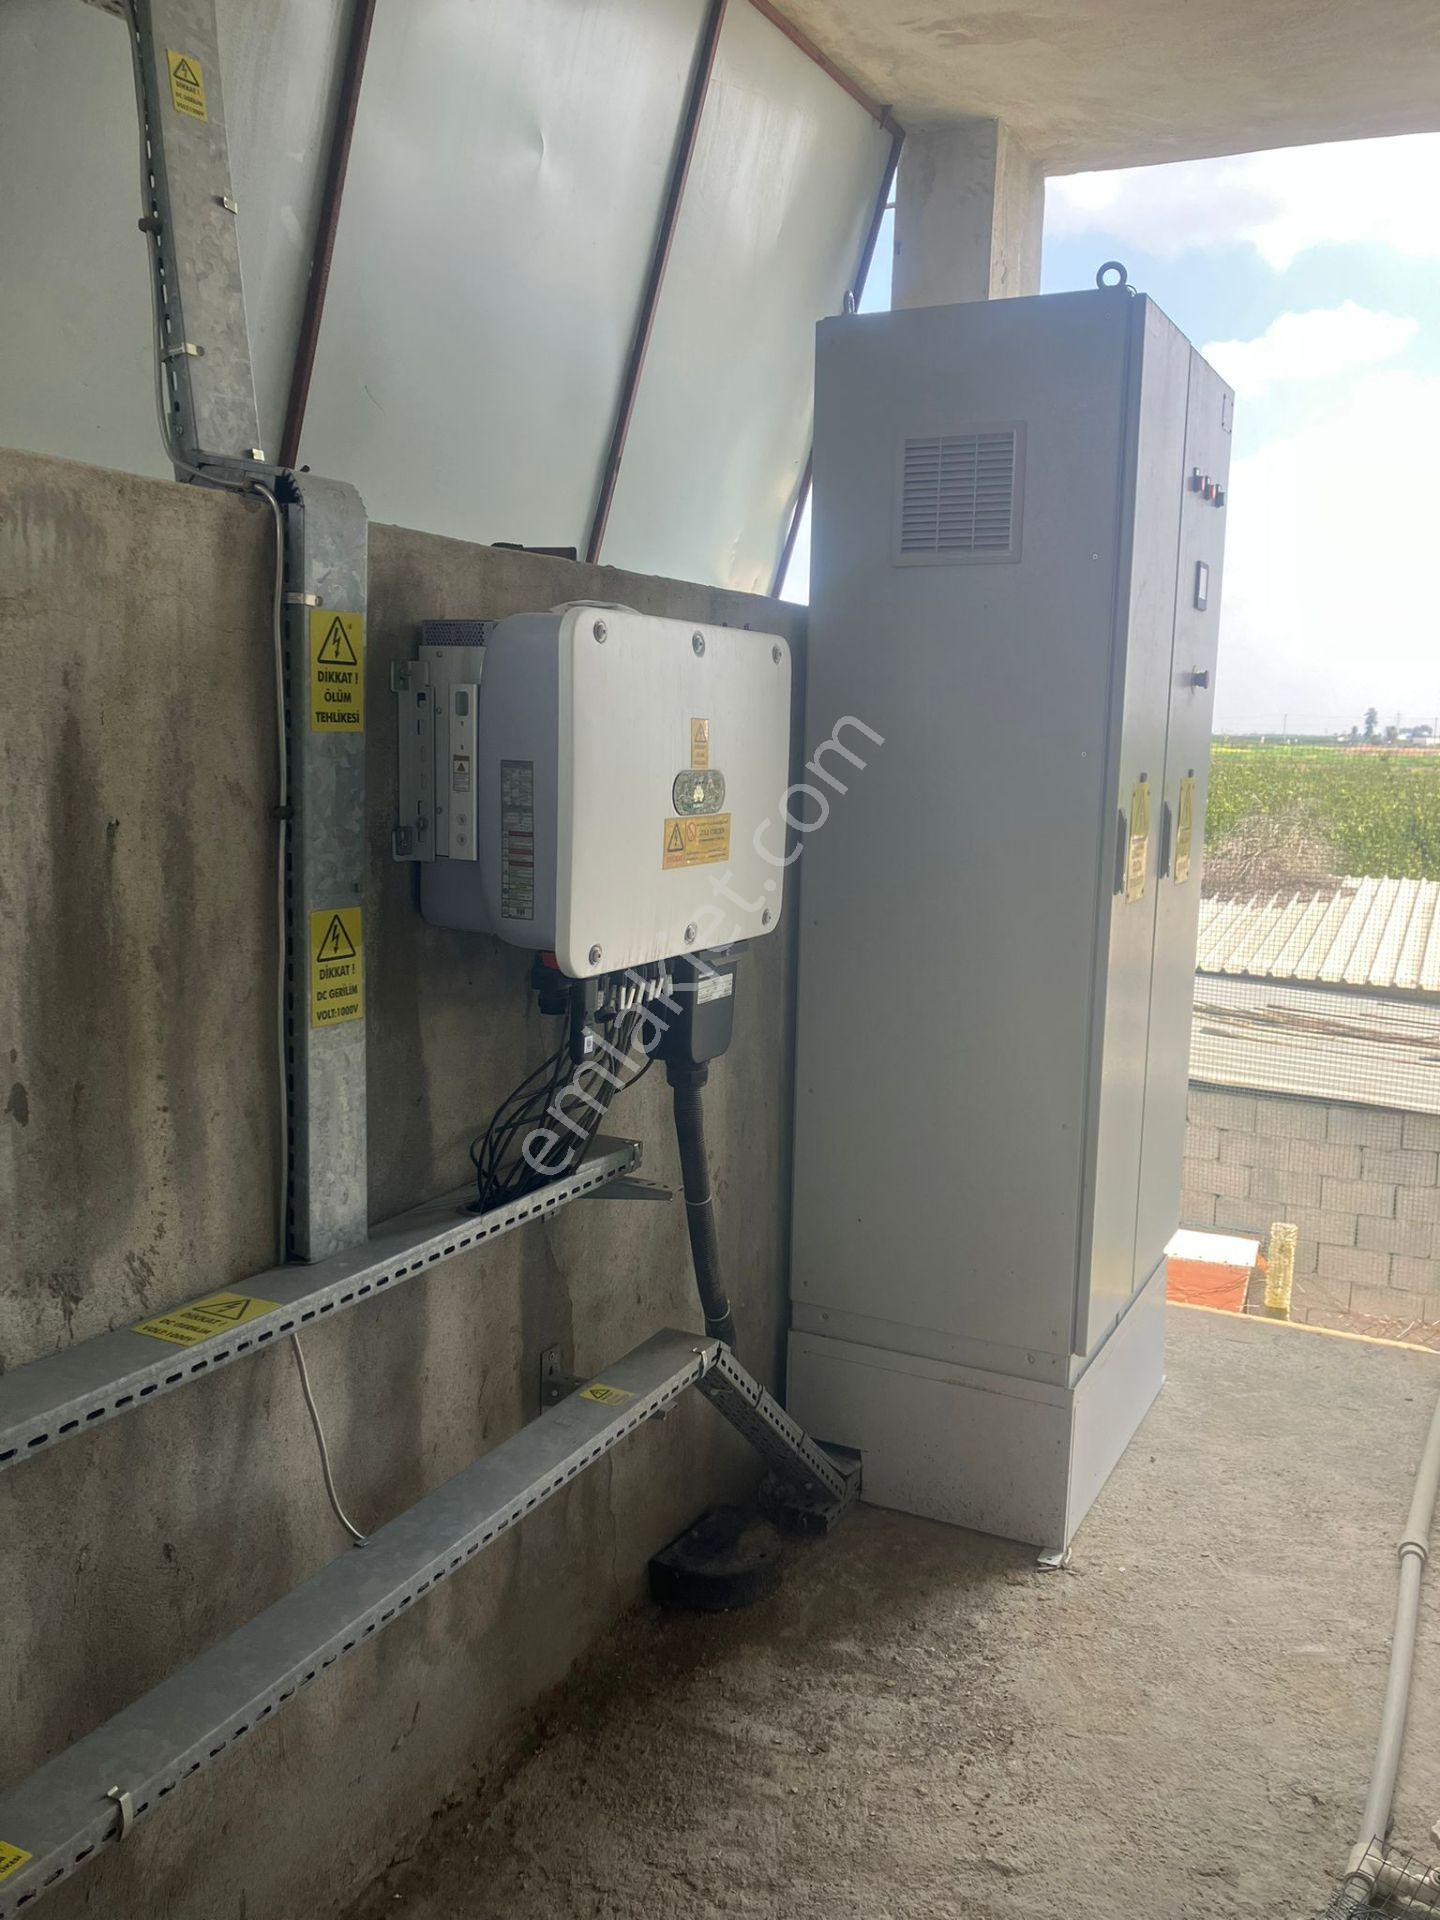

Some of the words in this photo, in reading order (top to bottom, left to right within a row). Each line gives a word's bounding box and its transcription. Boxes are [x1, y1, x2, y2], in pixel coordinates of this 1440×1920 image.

[317, 667, 352, 684] DİKKAT
[324, 688, 352, 703] ÖLÜM
[315, 709, 360, 724] TEHLİKESİ
[319, 965, 350, 980] DİKKAT
[317, 991, 327, 1001] DC
[329, 983, 358, 998] GERİLİM
